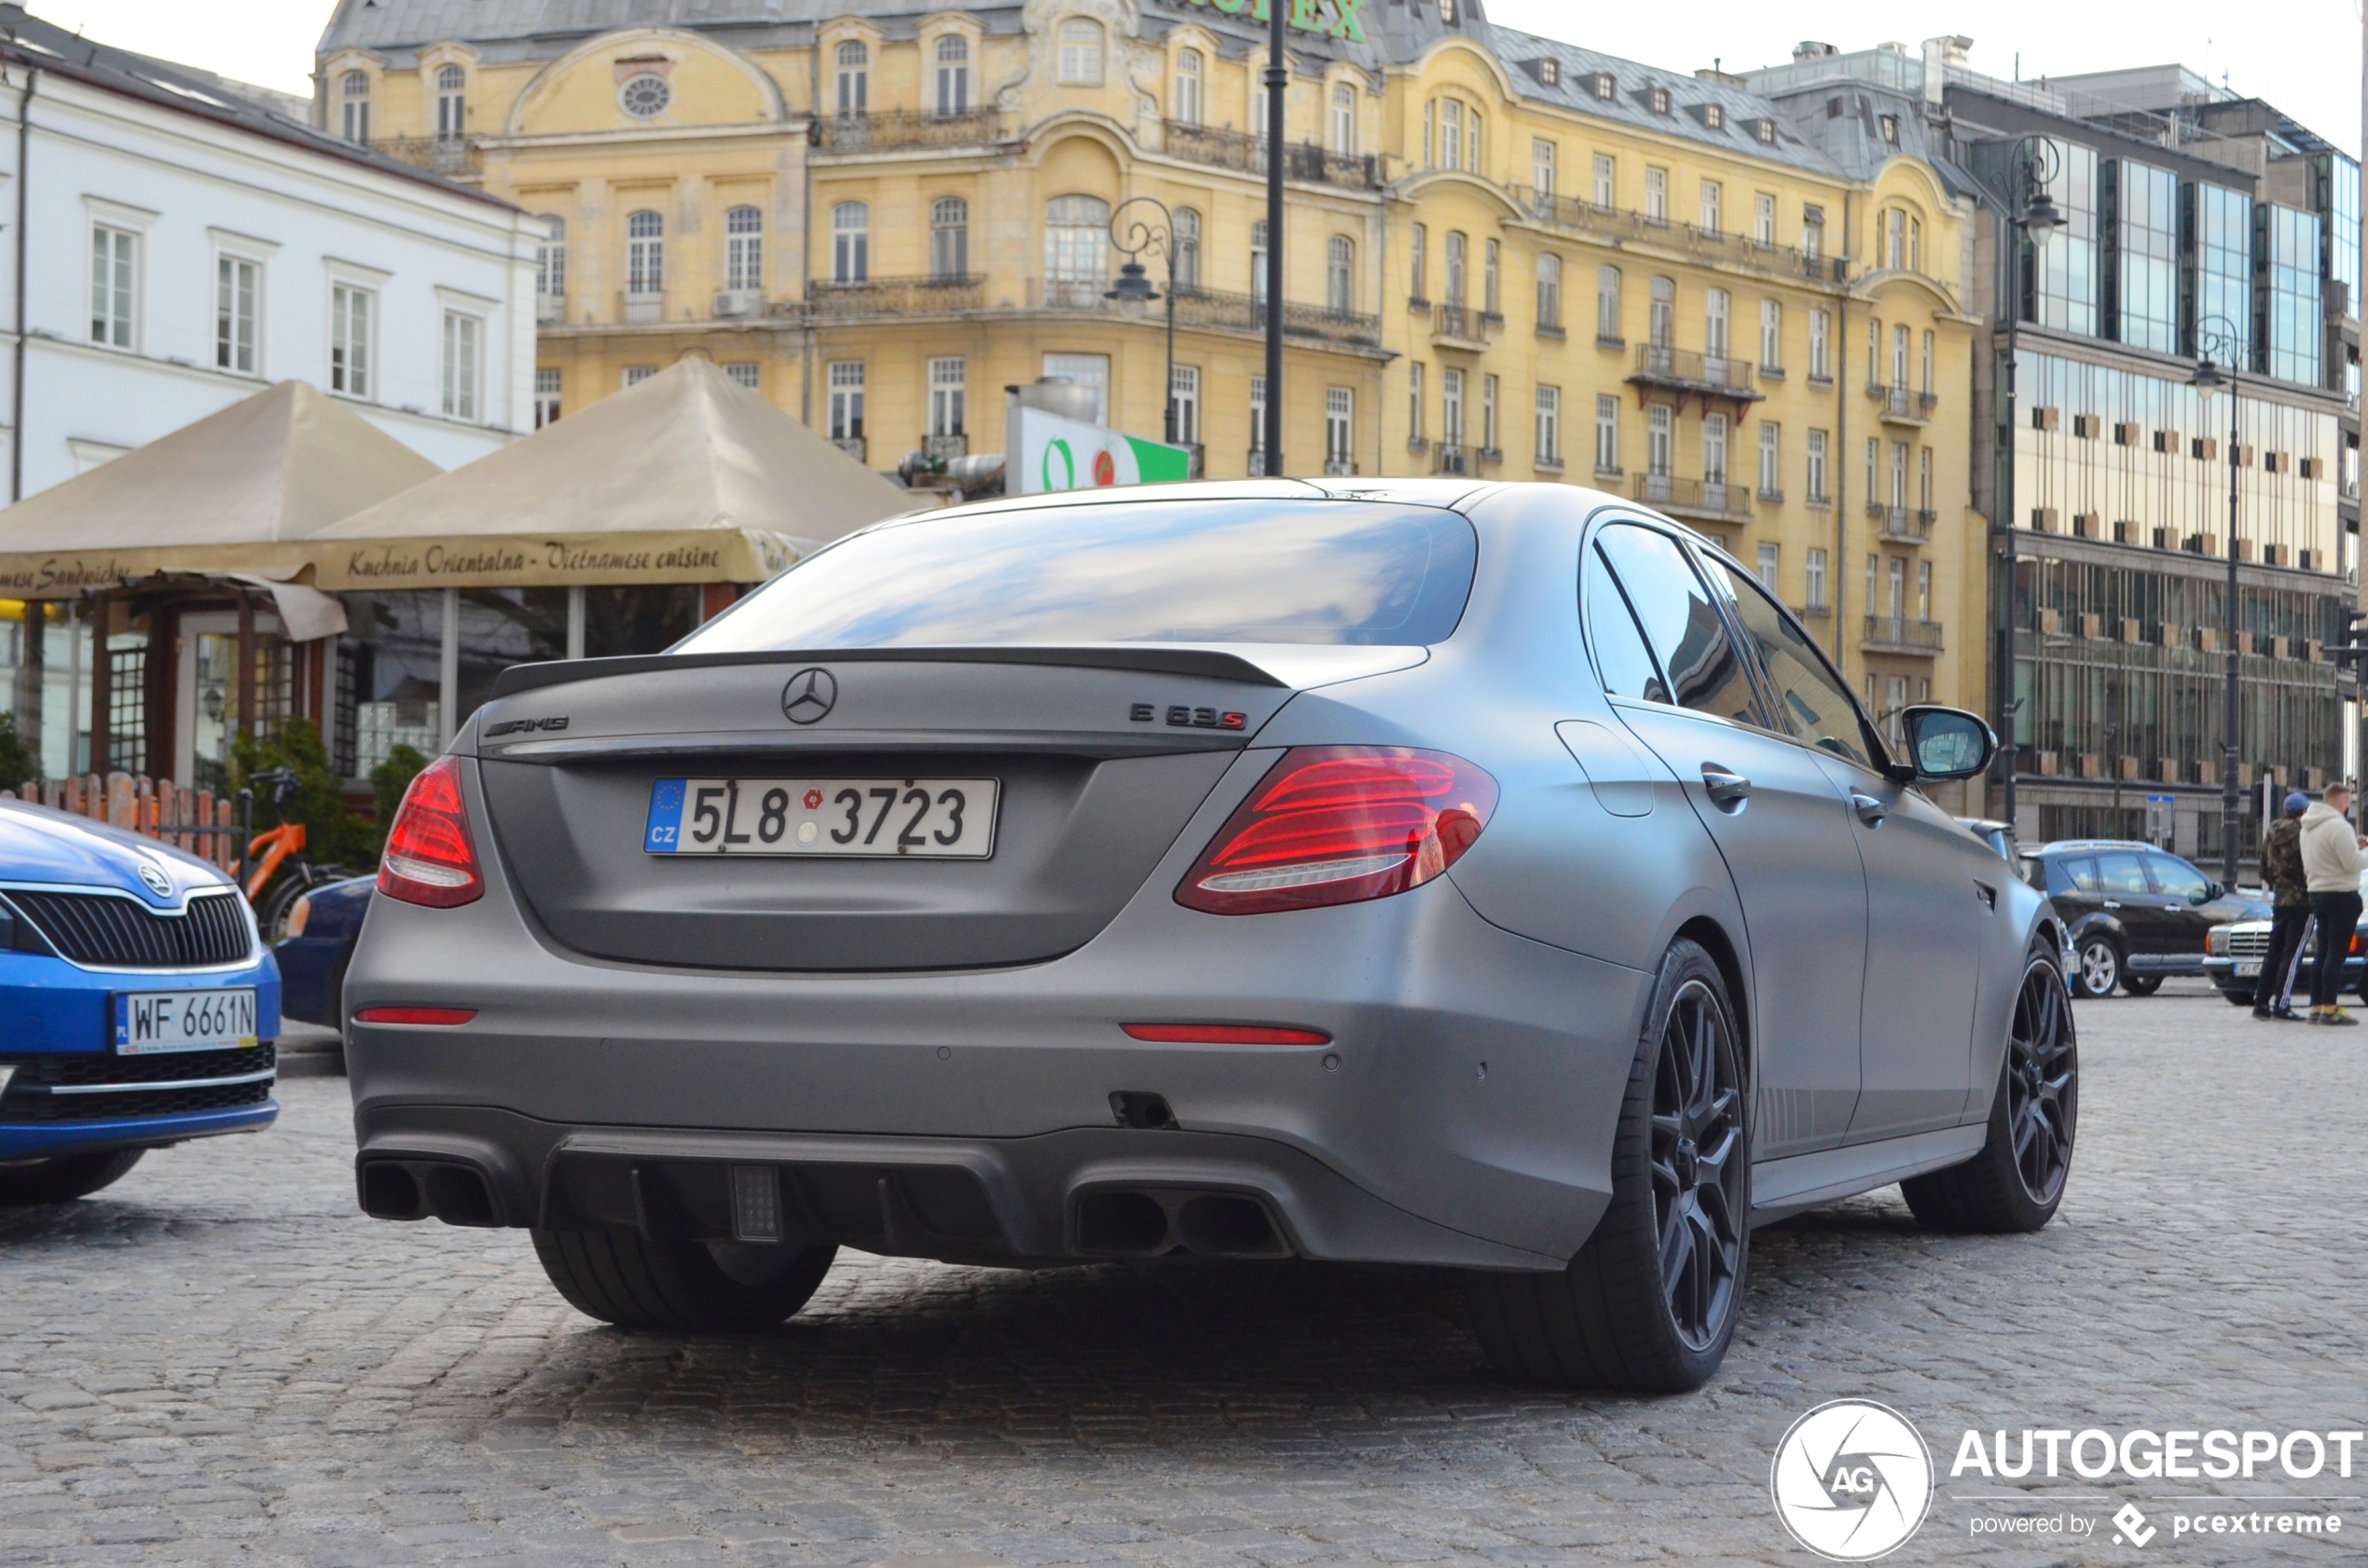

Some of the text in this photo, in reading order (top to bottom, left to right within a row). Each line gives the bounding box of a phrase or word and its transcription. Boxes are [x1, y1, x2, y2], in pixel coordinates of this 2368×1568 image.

[348, 545, 419, 576] Kuchnia
[425, 544, 524, 574] Orientalna
[545, 542, 650, 570] Vietnamese
[655, 546, 719, 569] cuisine
[1130, 703, 1154, 722] E
[492, 716, 570, 735] AMG
[692, 787, 966, 846] 5L8 3723
[651, 826, 676, 843] CZ
[134, 995, 253, 1040] WF 6661N
[117, 1025, 128, 1038] PL
